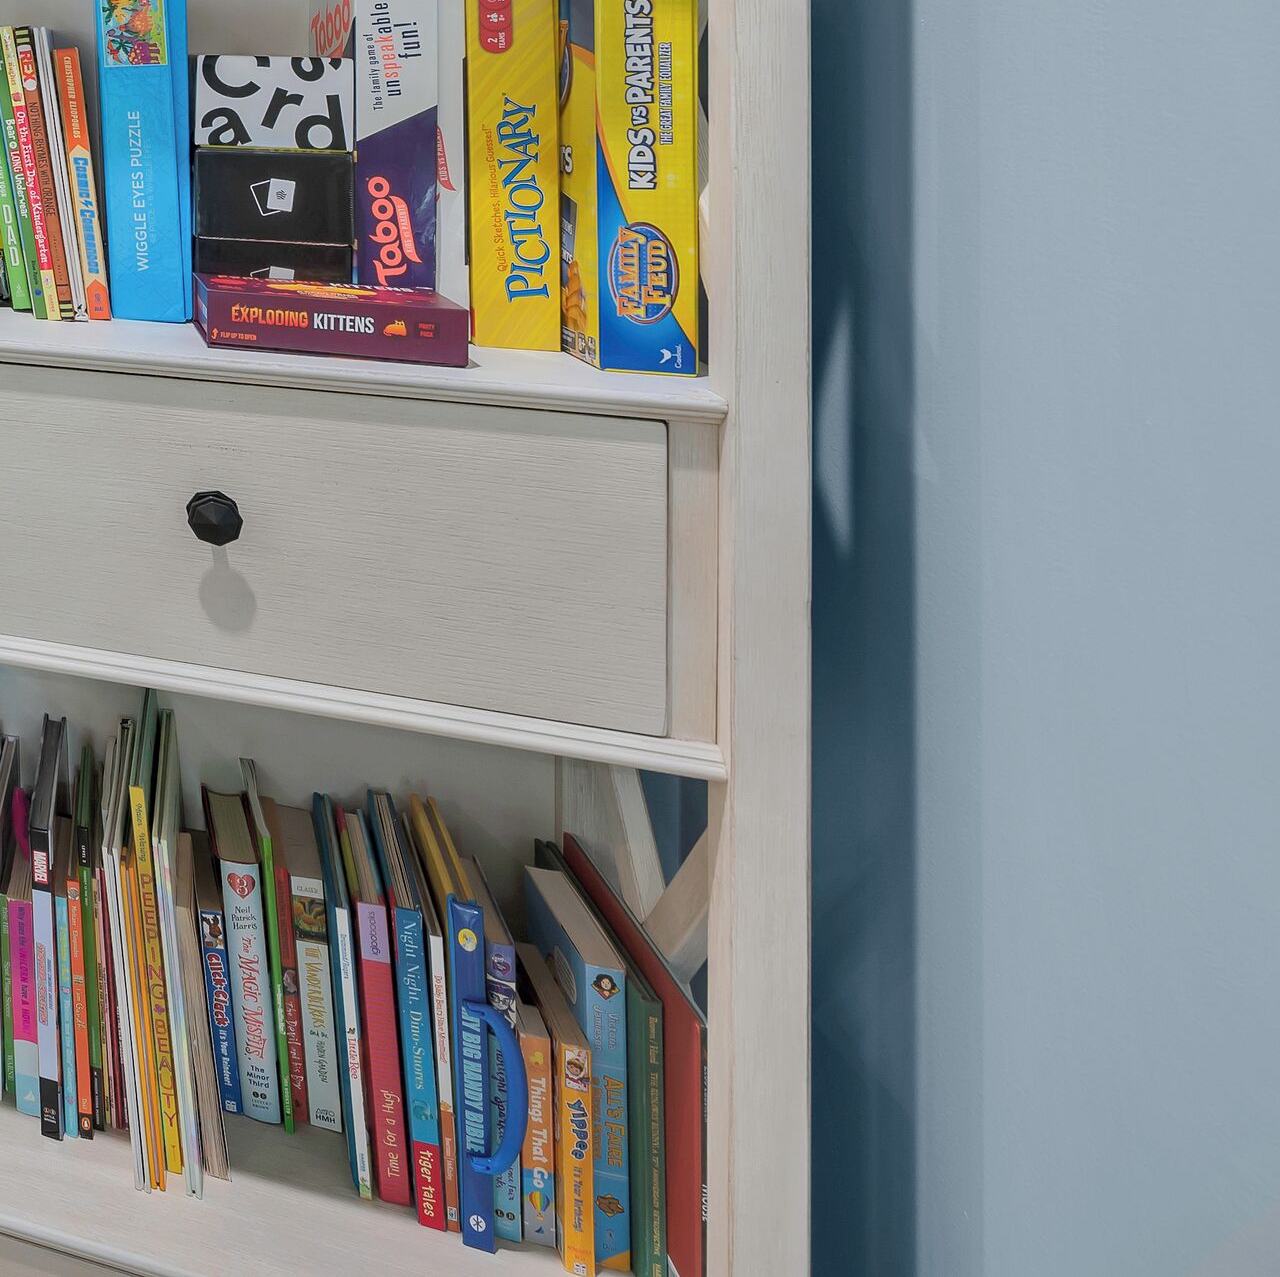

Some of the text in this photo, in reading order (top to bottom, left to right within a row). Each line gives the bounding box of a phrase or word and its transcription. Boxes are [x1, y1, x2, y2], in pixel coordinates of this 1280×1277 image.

[369, 1, 422, 98] unspeakable fun!
[498, 31, 506, 49] TEAMS
[63, 56, 76, 99] CHRISTOPHER
[362, 33, 384, 111] The family game of
[658, 41, 673, 146] THE GREAT FAMILY EQUALIZER
[16, 111, 26, 125] On
[20, 125, 28, 143] the
[631, 105, 649, 127] VS
[5, 118, 28, 219] Bear LONG Underwear
[22, 144, 34, 168] First
[25, 169, 36, 188] Day
[29, 102, 56, 217] NOTHING RHYMES WITH ORANGE
[627, 127, 658, 190] KIDS
[30, 190, 40, 200] of
[127, 110, 149, 272] WIGGLE EYES PUZZLE
[487, 163, 508, 272] Quick Sketches, Hilarious
[497, 95, 551, 304] PICTIONARY
[2, 204, 20, 267] DAD
[31, 201, 49, 264] Kindergarten
[367, 175, 408, 286] Taboo
[616, 225, 648, 319] FAMILY
[642, 237, 672, 309] FEUD
[220, 331, 231, 339] FLIP
[231, 302, 375, 334] EXPLODING KITTENS
[34, 850, 49, 884] MARVEL
[231, 912, 257, 922] Patrick
[232, 921, 258, 930] Harris
[234, 905, 251, 915] Neil
[18, 947, 27, 983] UNICORN
[141, 873, 175, 1128] PEEPING BEAUTY
[205, 952, 232, 1087] Click-Clack Reindeer!
[238, 936, 265, 1060] The MAGIC MISFITS
[402, 920, 425, 1091] Night Dino-Snores
[592, 1005, 604, 1052] Jamieson
[348, 1038, 359, 1080] Little Ree
[607, 1010, 619, 1052] Victoria
[246, 1072, 270, 1081] Minor
[247, 1079, 270, 1089] Third
[250, 1064, 265, 1073] The
[462, 1032, 485, 1154] BIG HANDY BIBLE
[316, 1114, 336, 1124] HMH
[381, 1089, 400, 1179] Time for a Hug!
[529, 1077, 549, 1189] Things That Go
[604, 1075, 626, 1169] ALL'S FAIRE
[420, 1148, 435, 1218] tiger tales
